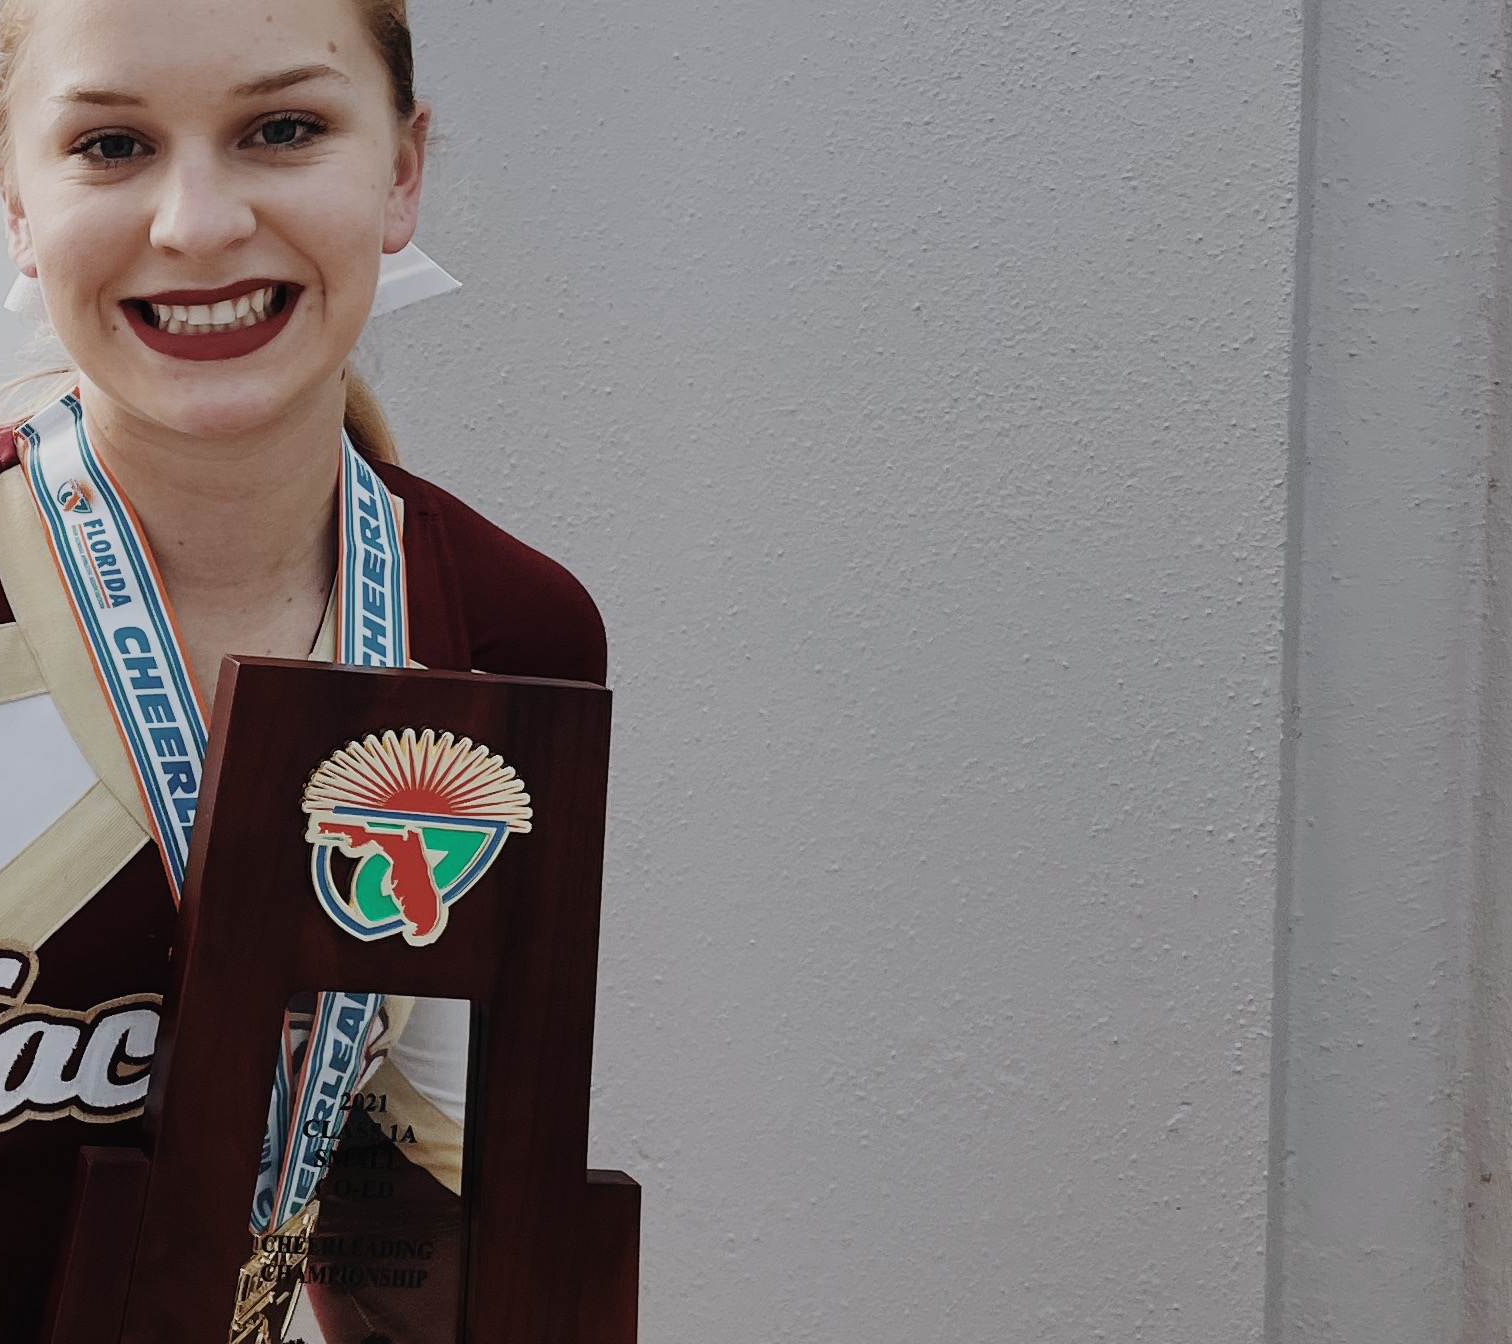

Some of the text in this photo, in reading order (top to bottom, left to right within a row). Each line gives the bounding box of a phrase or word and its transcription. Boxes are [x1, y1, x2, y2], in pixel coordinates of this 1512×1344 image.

[83, 518, 132, 608] FLORIDA
[113, 626, 197, 846] CHEERL
[339, 1092, 387, 1113] 2021
[391, 1124, 418, 1144] 1A
